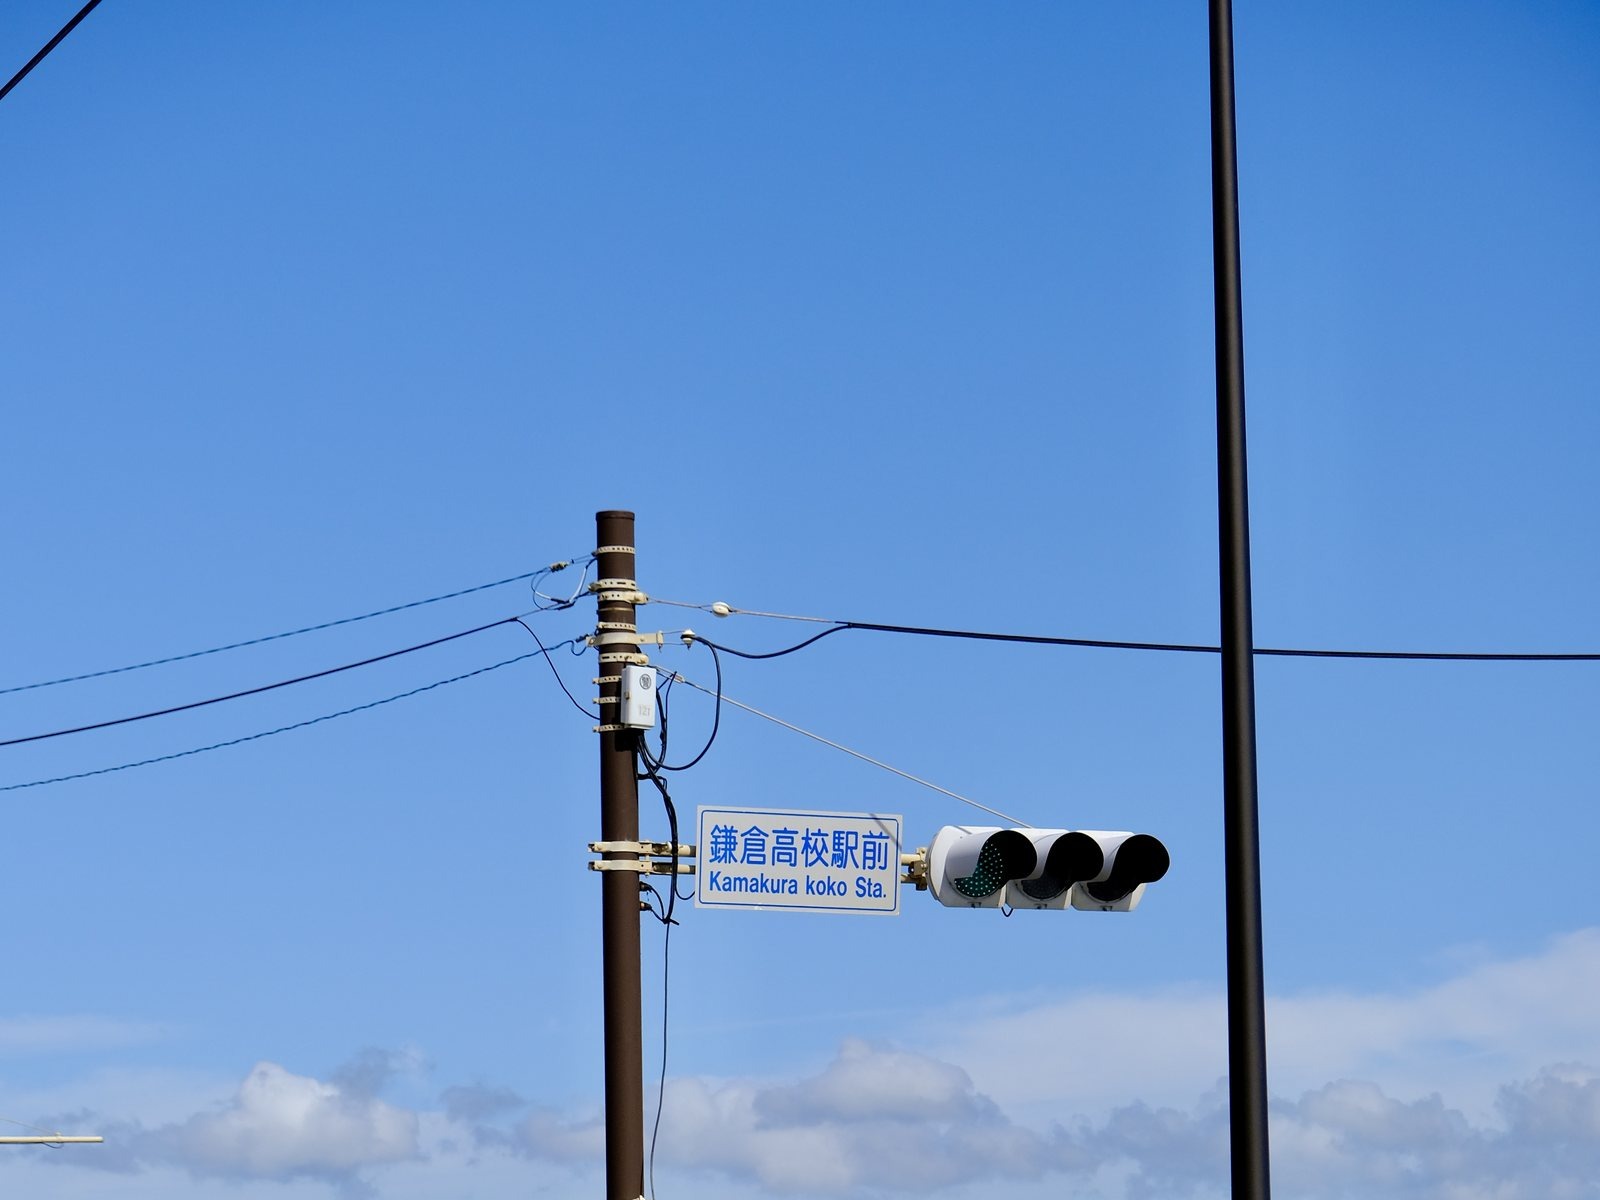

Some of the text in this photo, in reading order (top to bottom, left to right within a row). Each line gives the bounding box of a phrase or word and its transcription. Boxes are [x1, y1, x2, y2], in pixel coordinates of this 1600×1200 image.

[708, 824, 890, 870] 鎌倉高校駅前
[709, 870, 887, 898] Kamakura koko Sta.
